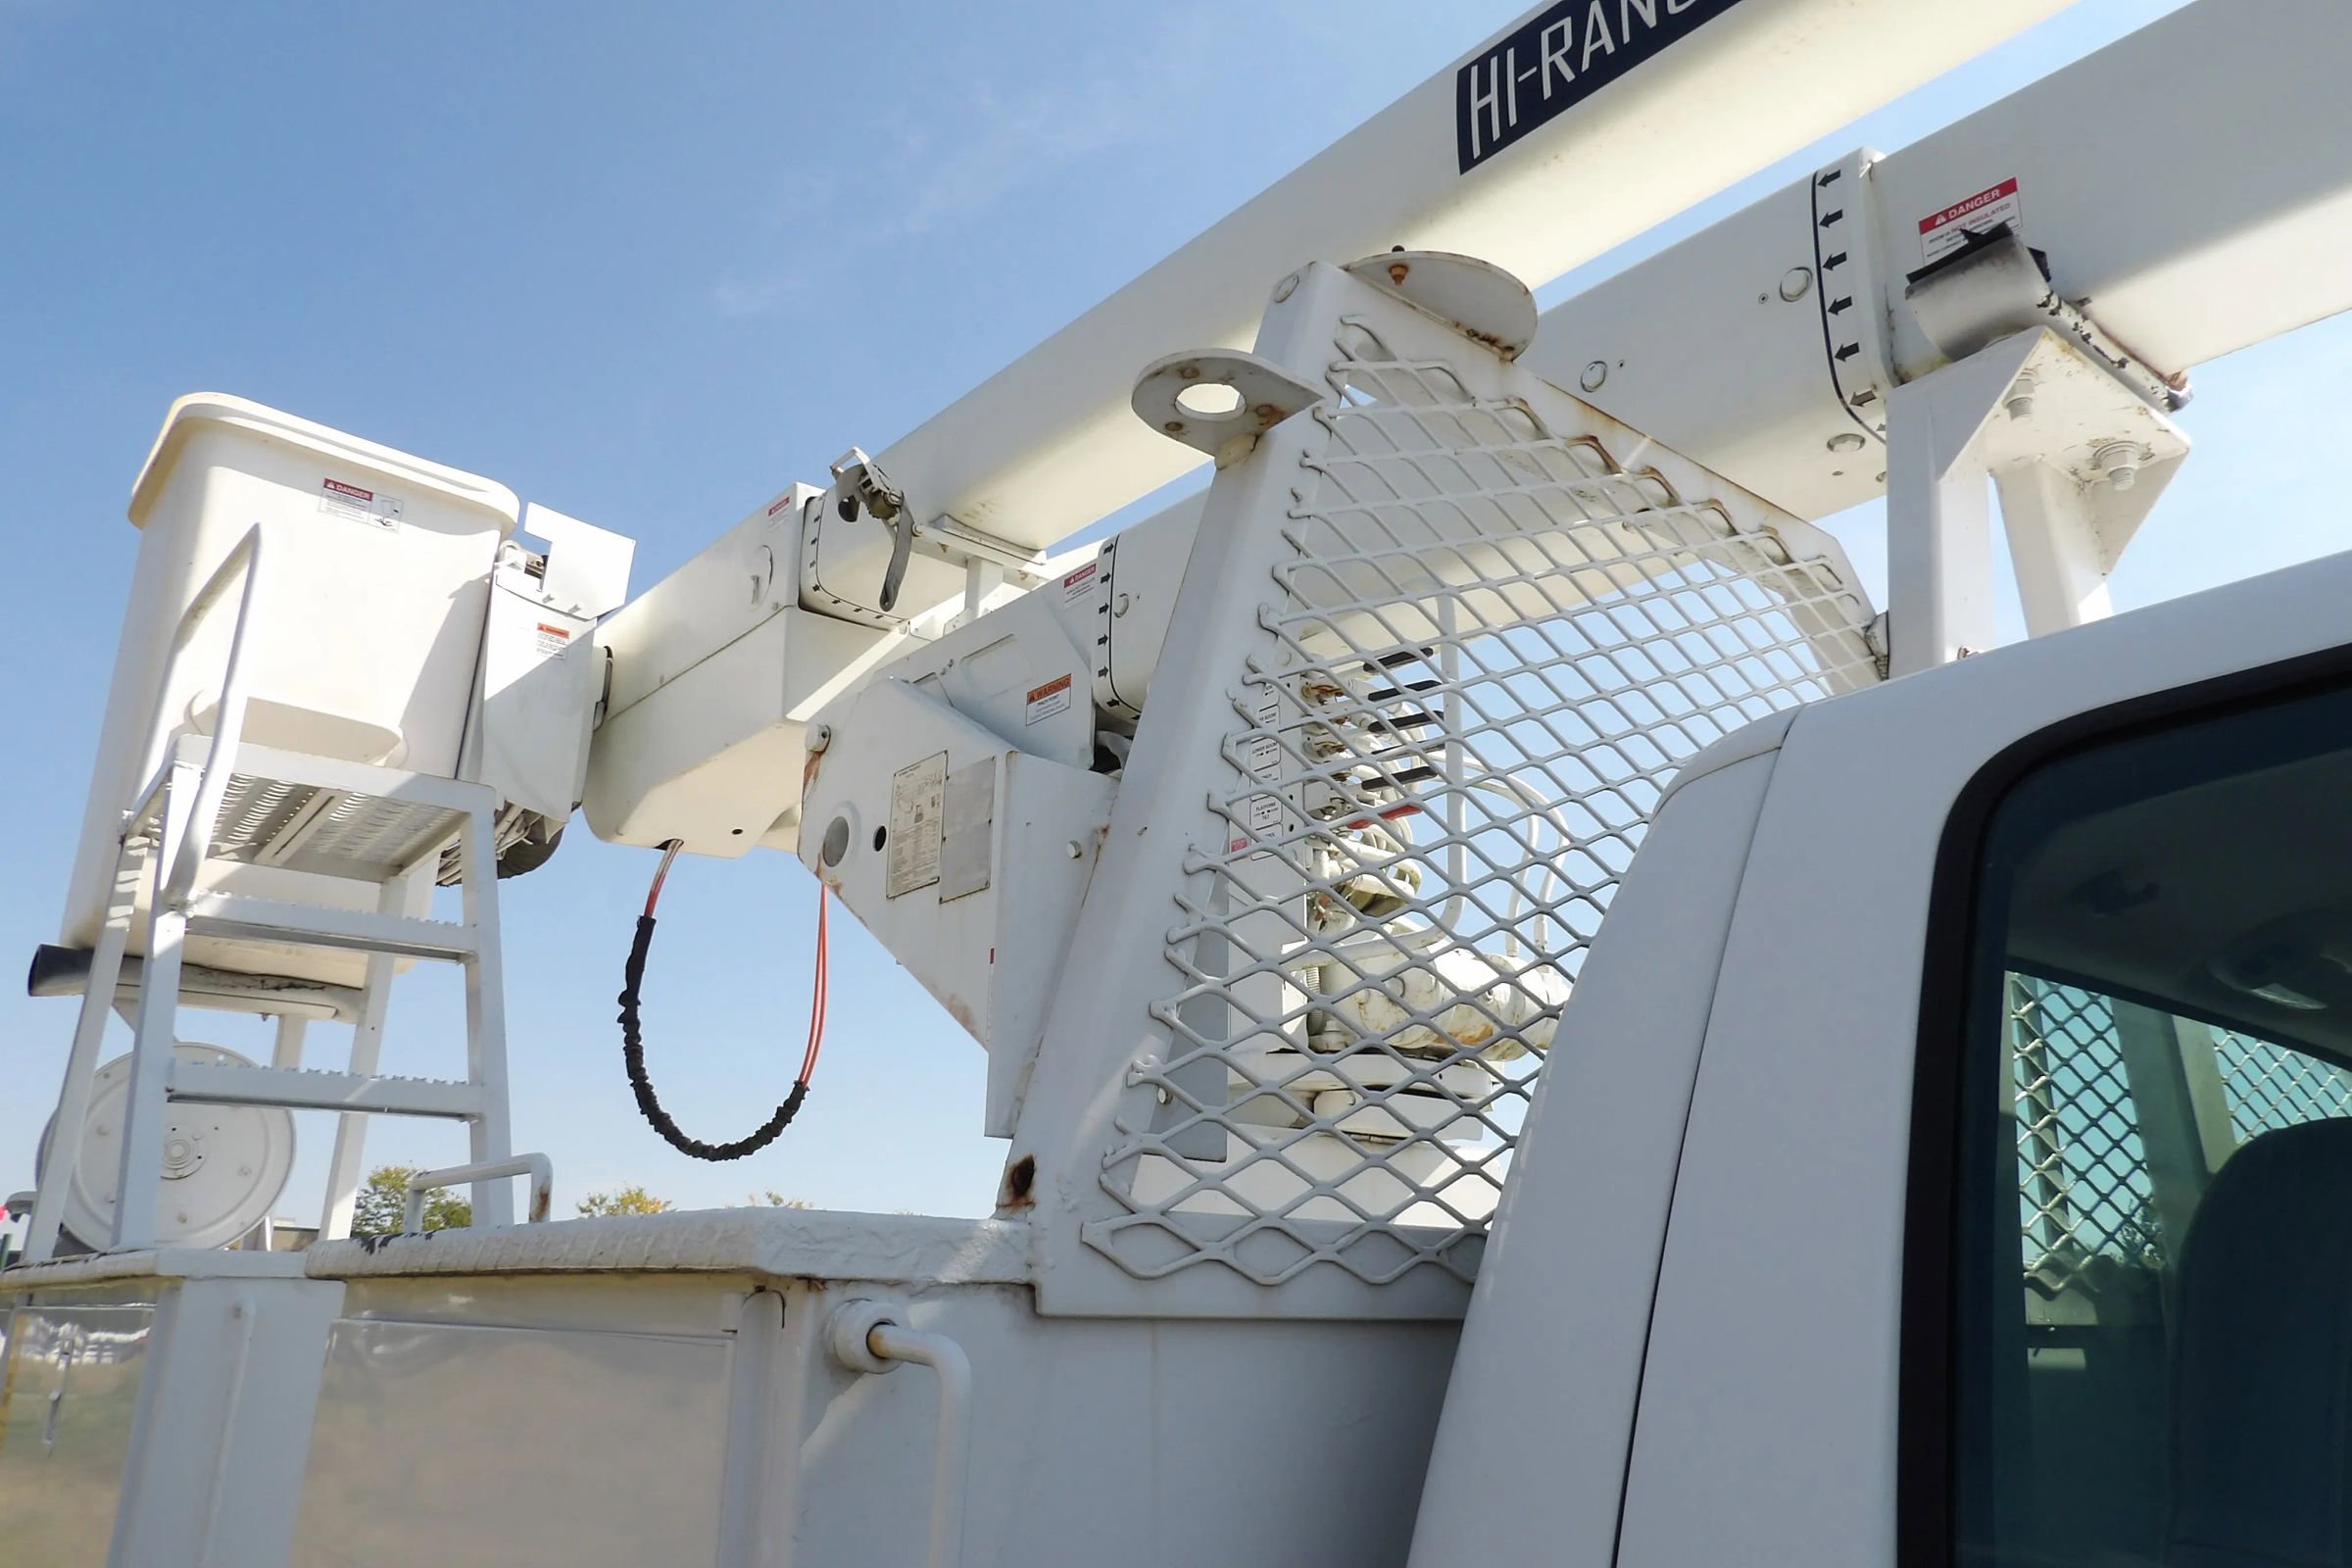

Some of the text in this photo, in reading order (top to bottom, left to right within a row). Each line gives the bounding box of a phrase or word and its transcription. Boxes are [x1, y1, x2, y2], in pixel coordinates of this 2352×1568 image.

[1471, 0, 1704, 160] HI-RAN
[1948, 188, 2000, 220] DANGER
[1969, 203, 2011, 224] INSULATED
[336, 484, 370, 499] DANGER
[1036, 677, 1070, 699] WARNING
